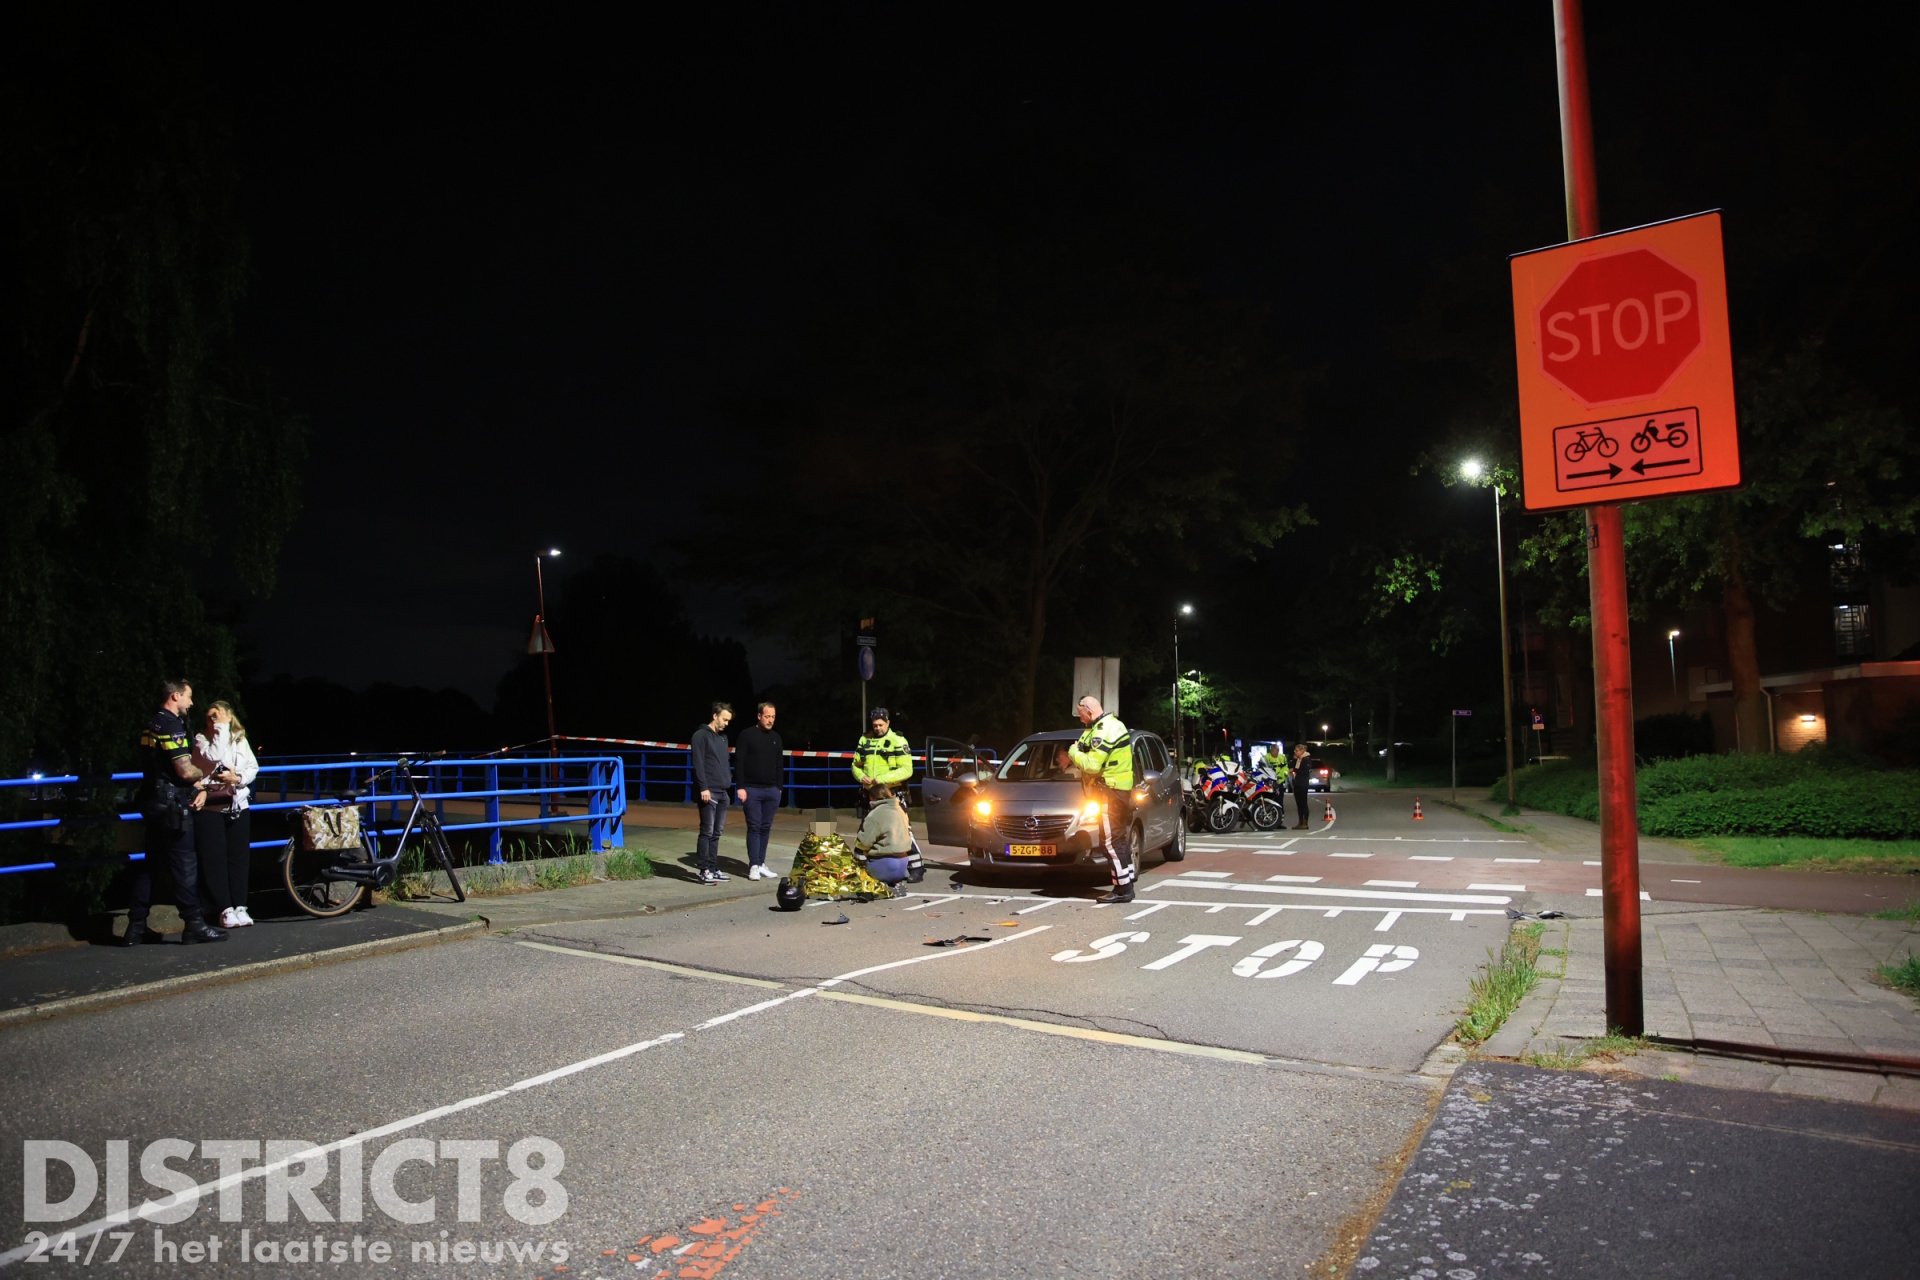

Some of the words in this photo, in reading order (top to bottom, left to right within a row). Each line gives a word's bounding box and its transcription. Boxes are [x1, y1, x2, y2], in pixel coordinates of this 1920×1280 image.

[1547, 290, 1691, 362] STOP
[1012, 846, 1053, 855] 5-ZGP-88
[1050, 931, 1420, 986] STOP
